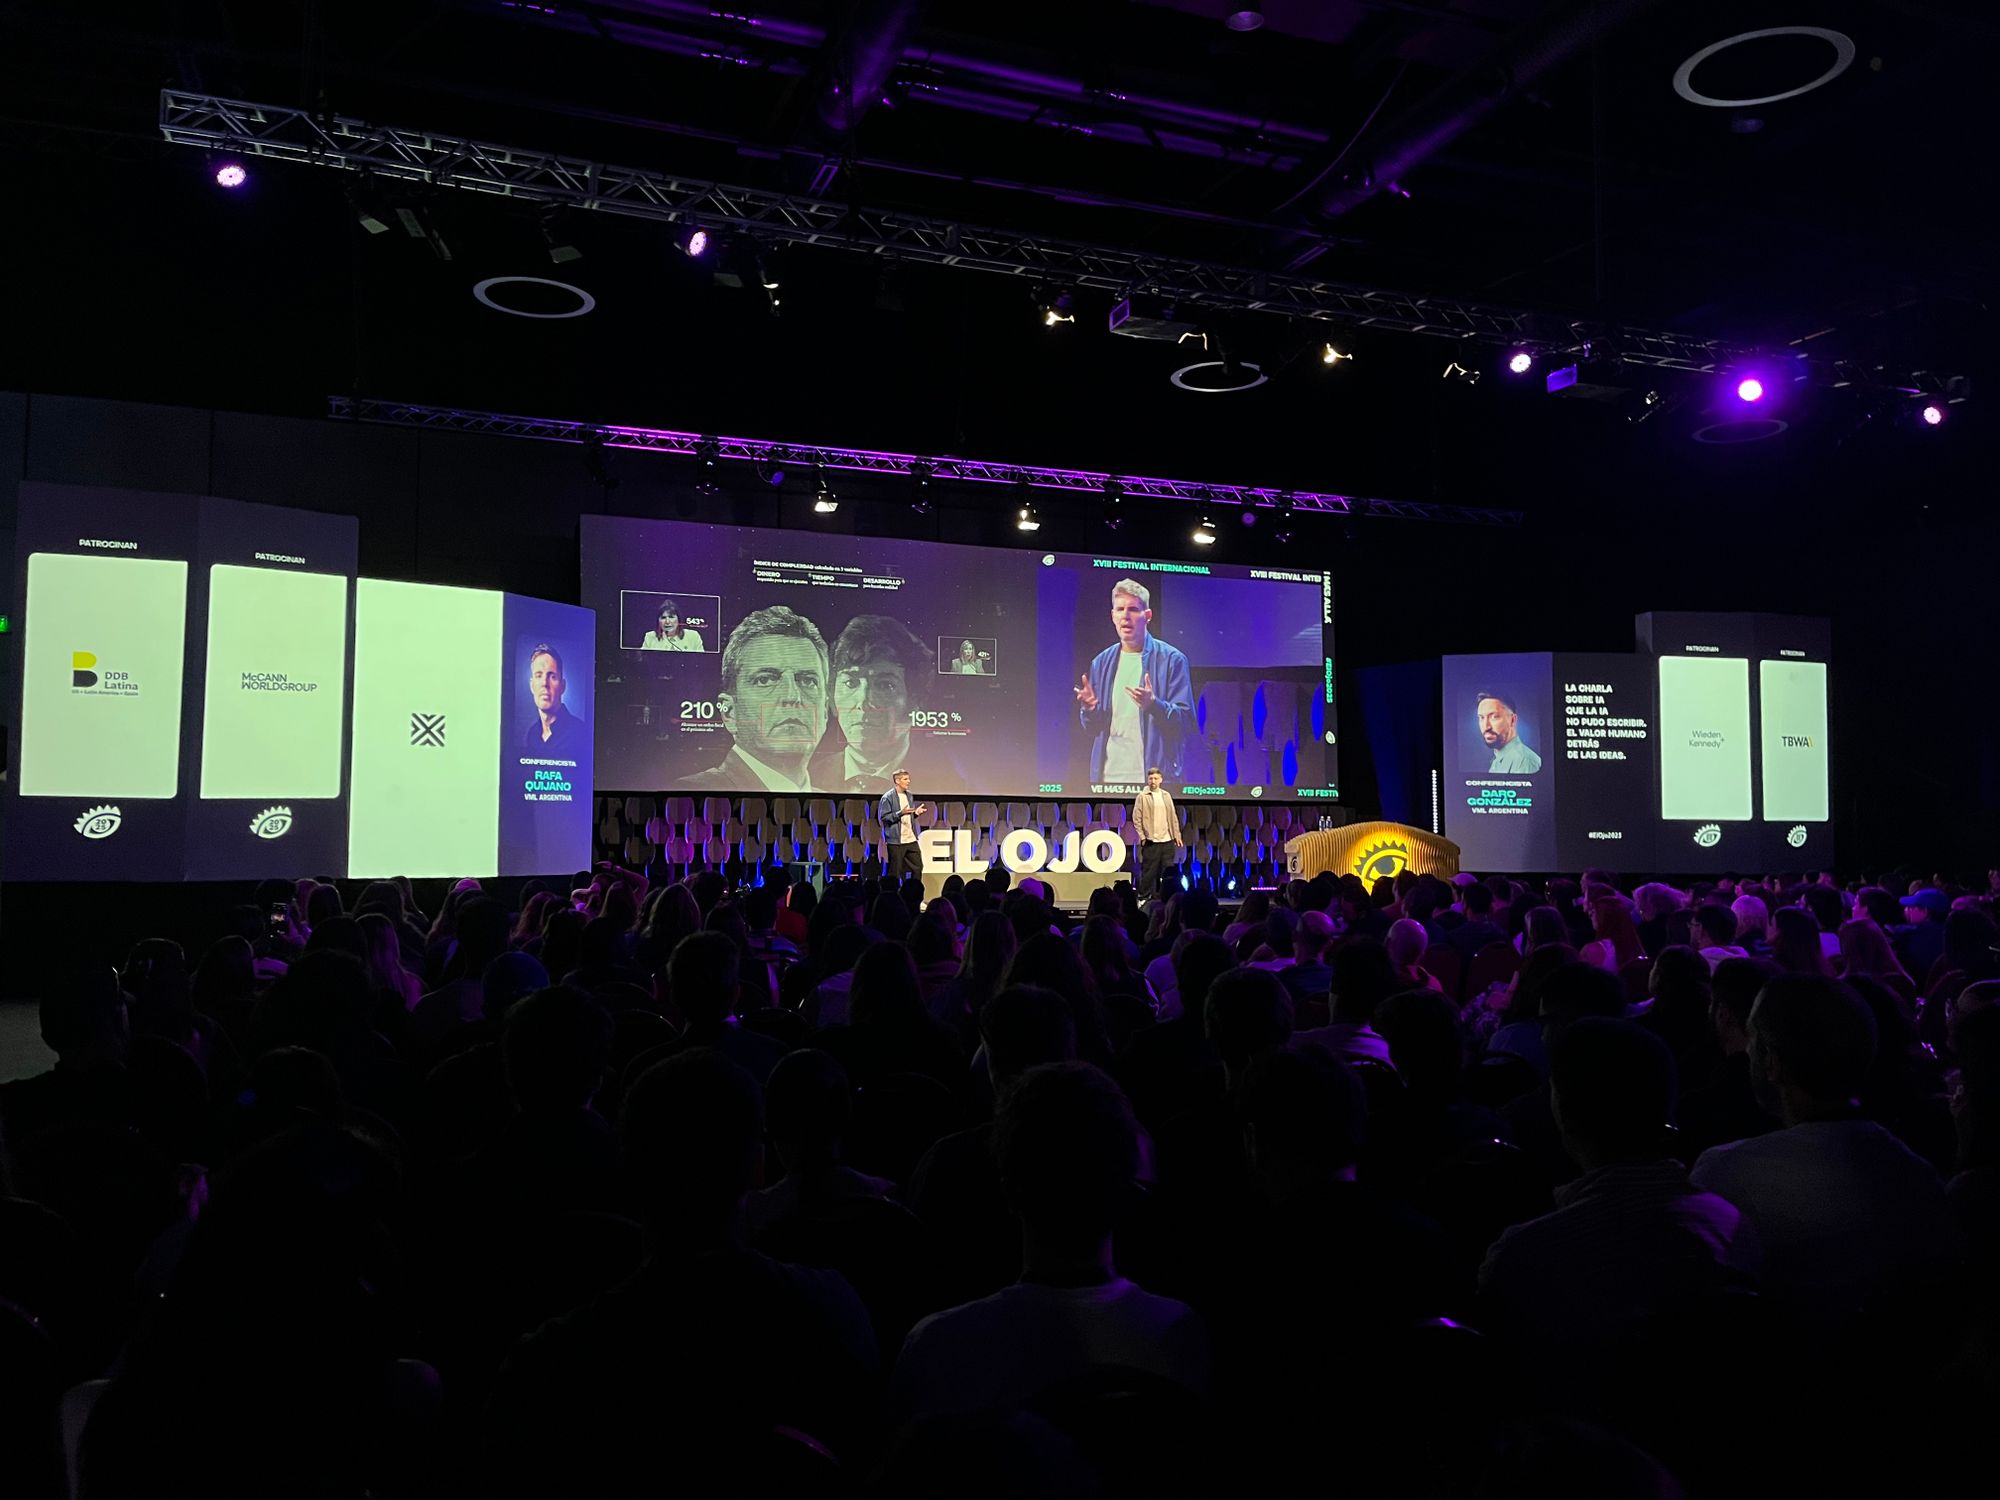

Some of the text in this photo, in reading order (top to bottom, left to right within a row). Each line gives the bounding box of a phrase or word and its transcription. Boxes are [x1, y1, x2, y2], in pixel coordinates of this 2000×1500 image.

[79, 538, 138, 550] PATROCINAN
[254, 552, 306, 564] PATROCINAN
[1093, 559, 1211, 575] XVIII FESTIVAL INTERNACIONAL
[756, 570, 781, 578] DINERO
[812, 574, 835, 582] TIEMPO
[1250, 570, 1268, 579] XVIII
[1268, 571, 1302, 582] FESTIVAL
[863, 577, 901, 586] DESARROLLO
[104, 671, 129, 681] DDB
[241, 672, 288, 683] McCANN
[104, 681, 139, 691] Latina
[241, 681, 318, 692] WORLDGROUP
[1565, 683, 1613, 694] LA CHARLA
[1565, 695, 1594, 704] SOBRE
[1565, 706, 1584, 716] QUE
[1586, 706, 1598, 716] LA
[1566, 718, 1648, 728] NO PUDO ESCRIBIR.
[1566, 728, 1647, 739] EL VALOR HUMANO
[1692, 730, 1721, 739] Wieden
[1566, 738, 1600, 749] DETRÁS
[1567, 750, 1627, 760] DE LAS IDEAS.
[520, 757, 577, 767] CONFERENCISTA
[534, 770, 563, 781] RAFA
[525, 781, 572, 792] QUIJANO
[1039, 784, 1063, 793] 2025
[1125, 785, 1144, 794] ALL
[524, 793, 573, 802] VML ARGENTINA
[1297, 788, 1315, 798] XVIII
[1481, 789, 1517, 799] DARO
[1466, 796, 1533, 807] GONZÁLEZ
[918, 829, 1127, 874] EL OJO
